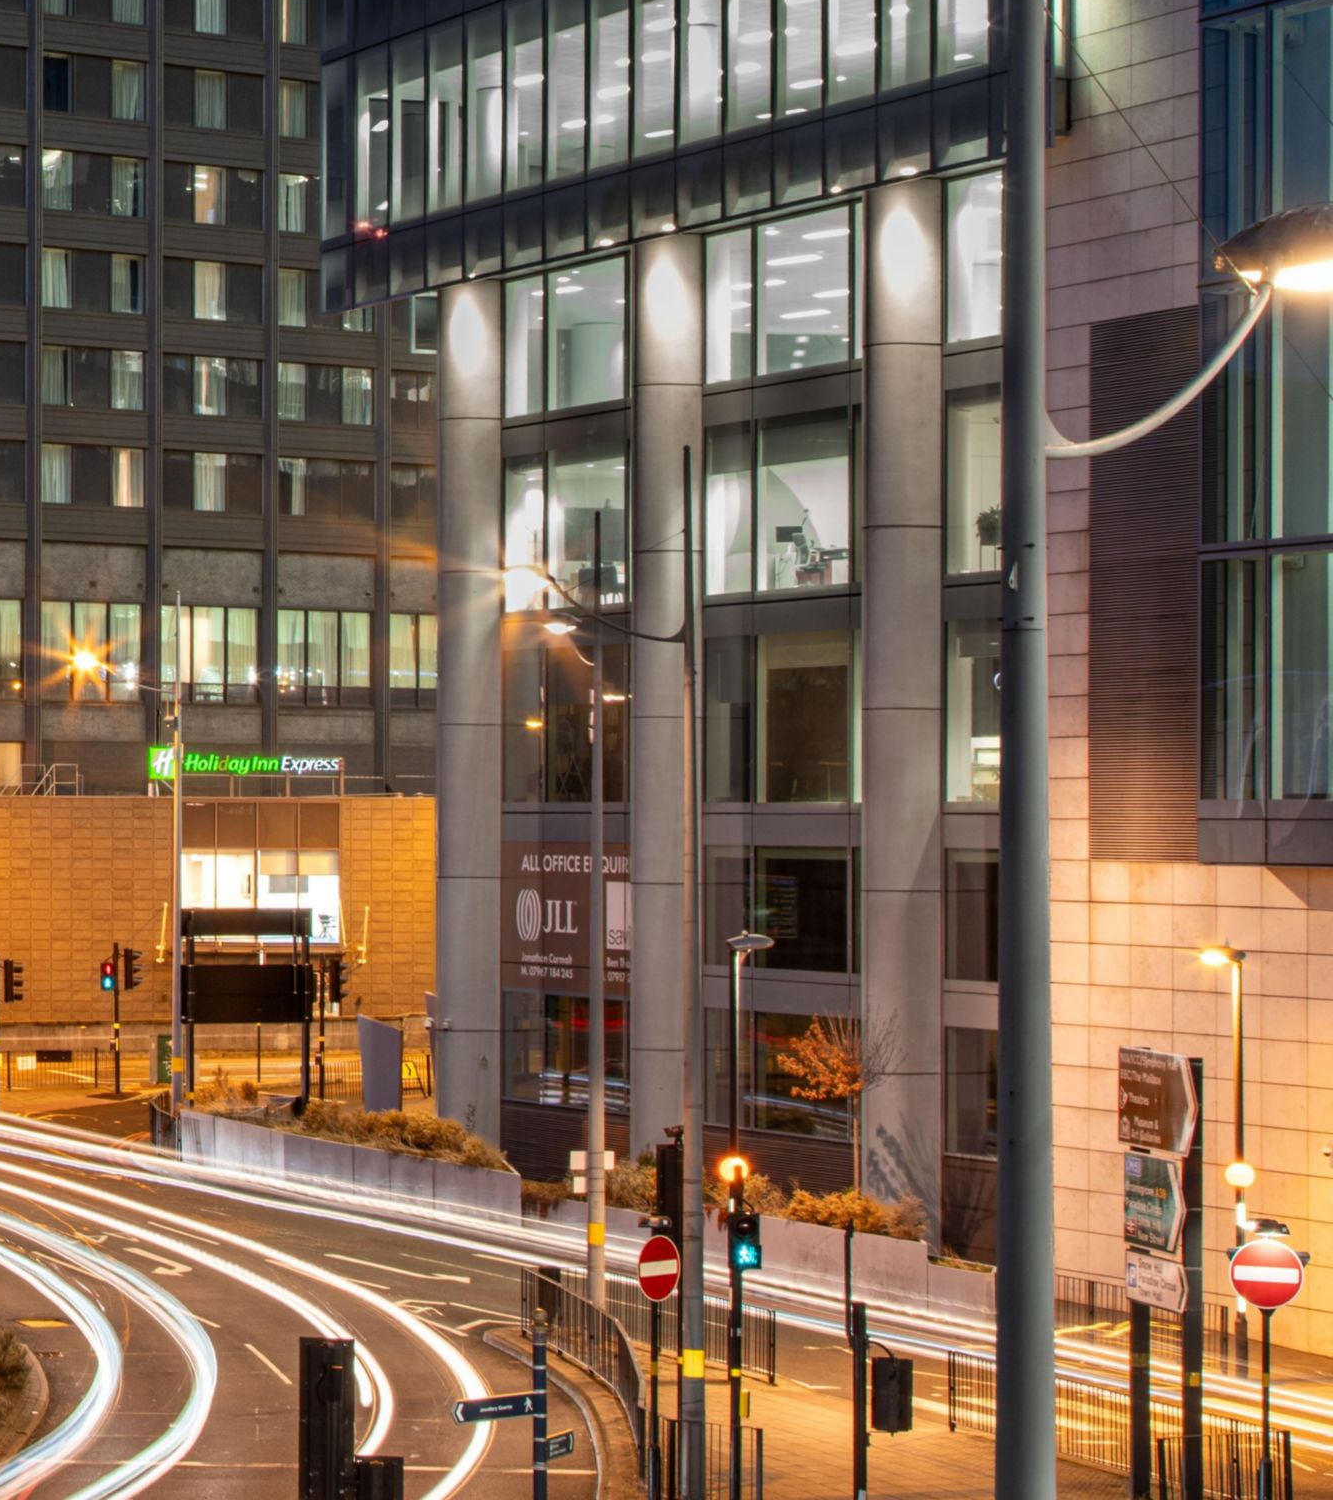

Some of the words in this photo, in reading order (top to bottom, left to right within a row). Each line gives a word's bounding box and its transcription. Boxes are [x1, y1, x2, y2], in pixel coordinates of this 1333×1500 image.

[184, 753, 253, 775] Holiday
[253, 755, 280, 771] Inn
[281, 756, 340, 775] Express
[521, 854, 540, 871] ALL
[543, 854, 581, 873] OFFICE
[543, 900, 578, 934] JLL
